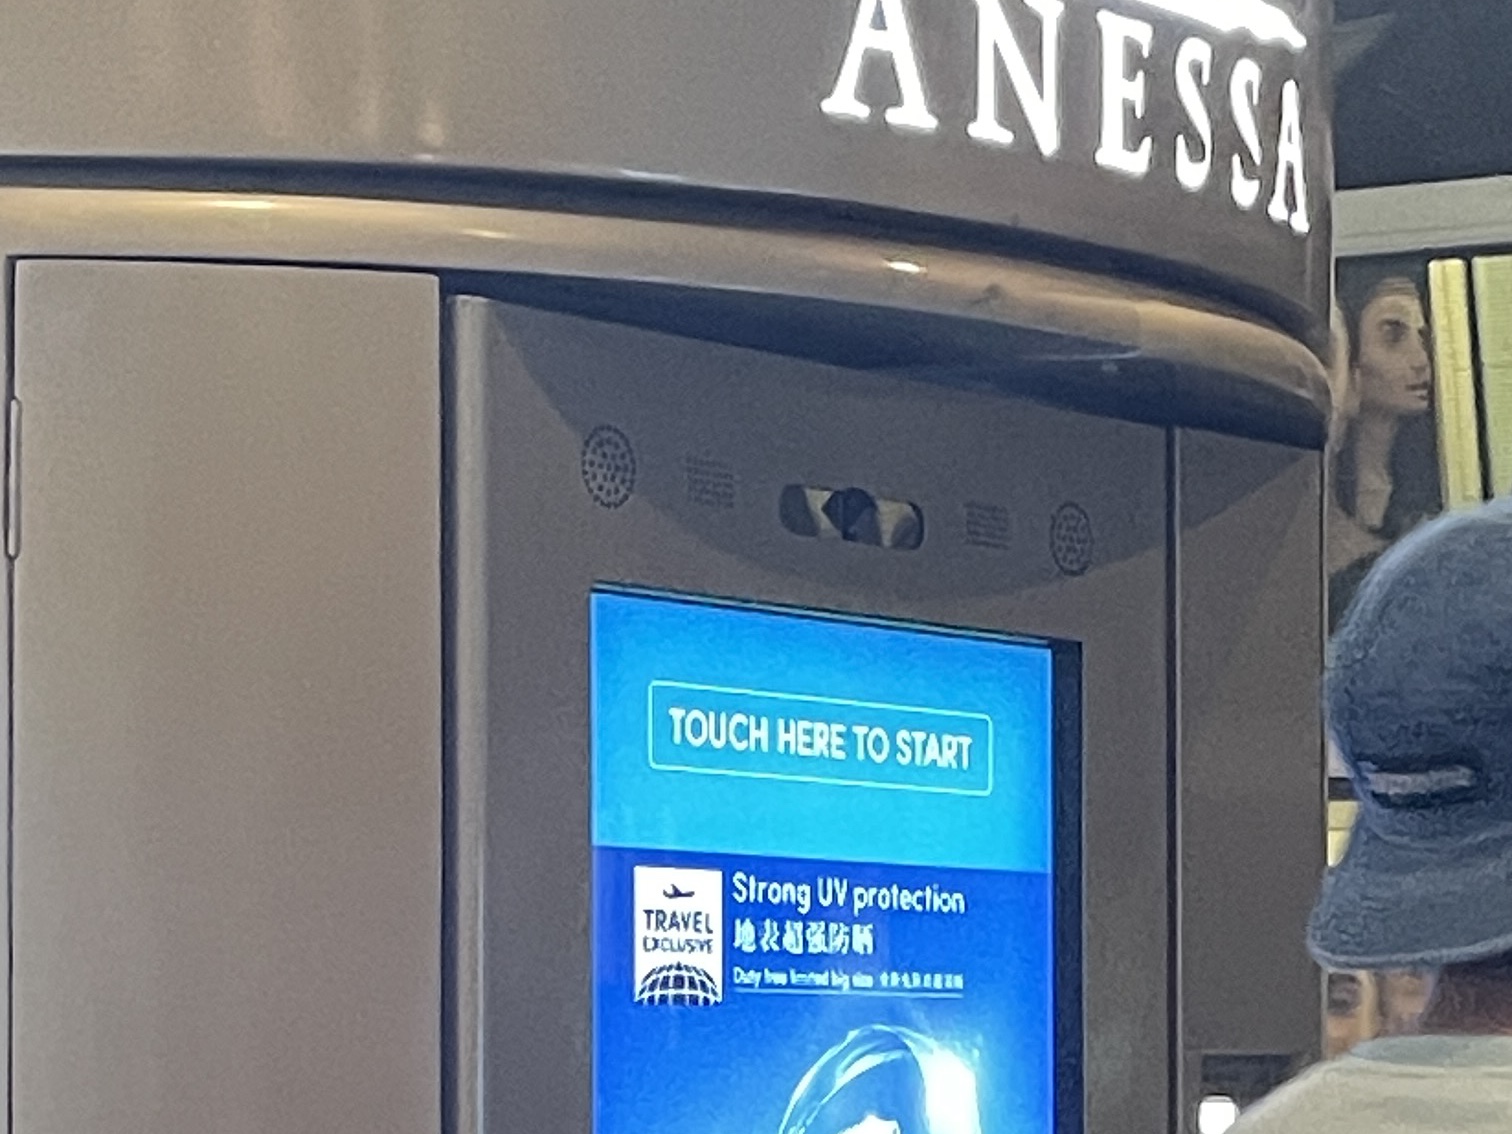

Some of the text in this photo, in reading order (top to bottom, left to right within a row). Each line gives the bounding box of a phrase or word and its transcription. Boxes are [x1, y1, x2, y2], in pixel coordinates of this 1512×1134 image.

[820, 0, 1310, 234] ANESSA
[668, 707, 972, 770] TOUCH HERE TO START
[732, 871, 966, 917] Strong UV protection
[642, 935, 714, 955] EXCLUSIVE
[643, 909, 714, 935] TRAVEL
